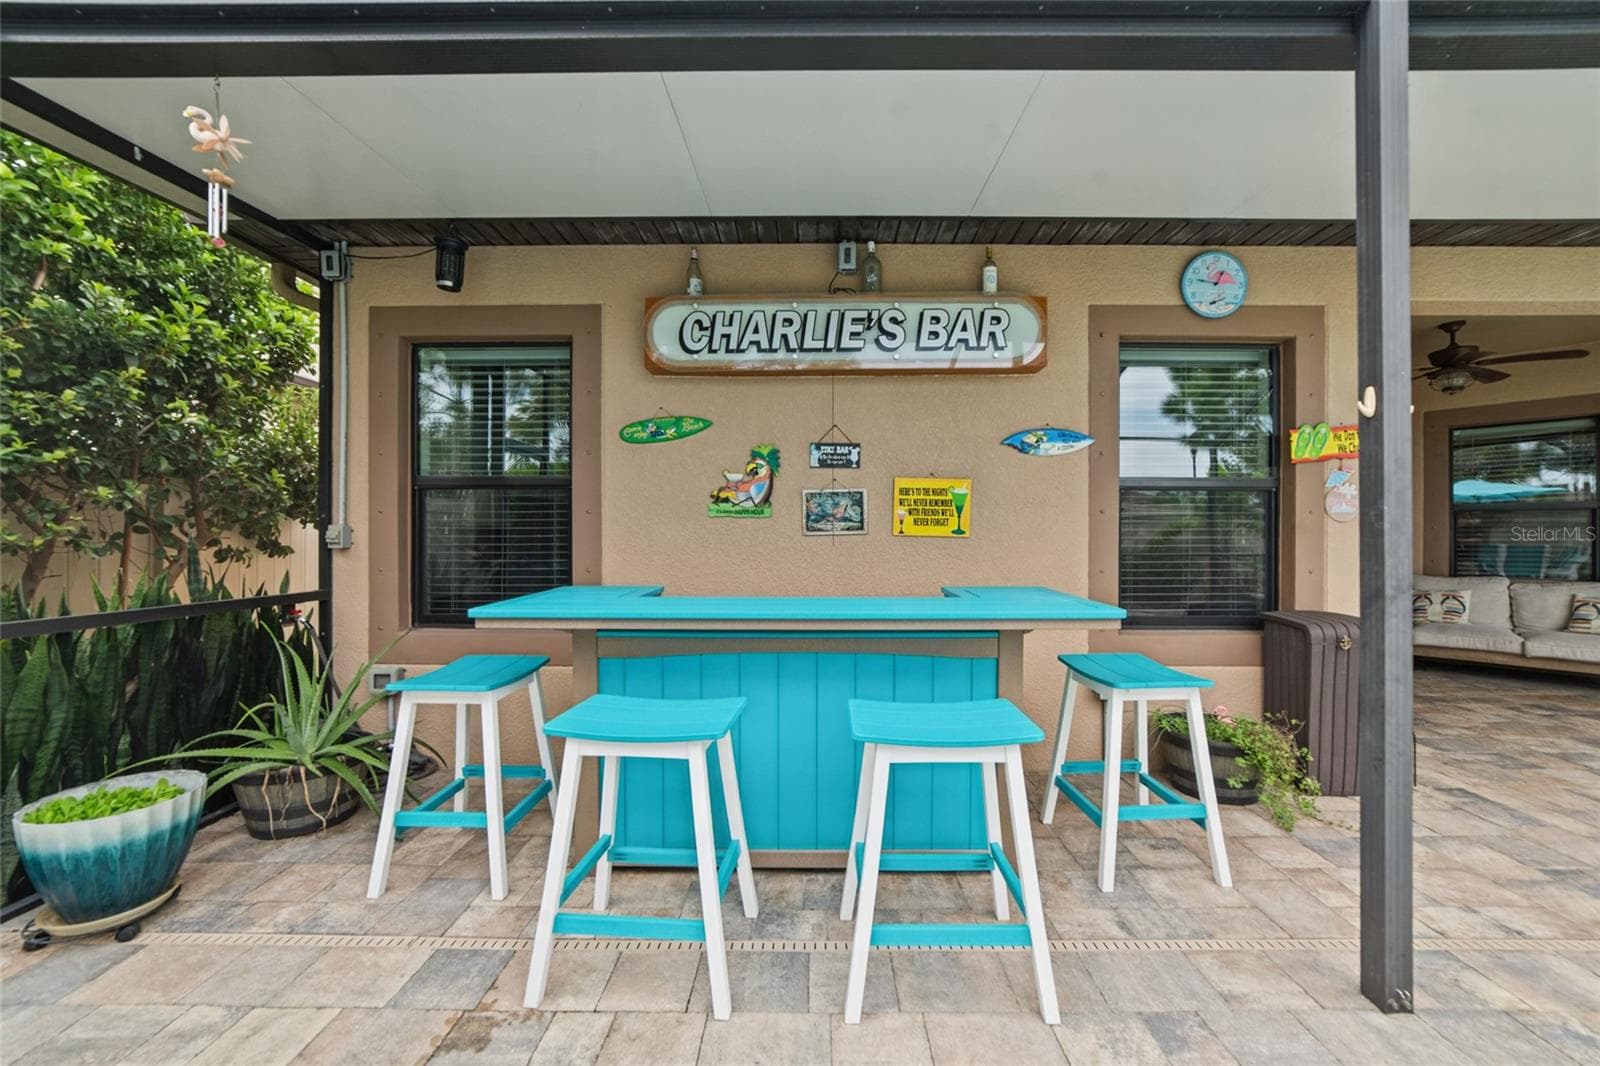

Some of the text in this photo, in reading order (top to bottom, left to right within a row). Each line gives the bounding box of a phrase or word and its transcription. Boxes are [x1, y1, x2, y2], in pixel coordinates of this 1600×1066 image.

[679, 307, 1011, 353] CHARLIE'S BAR
[836, 445, 849, 454] BAR
[899, 487, 948, 497] HERE'S TO THE NIGHTS
[899, 498, 953, 507] WE'LL NEVER REMEMBER
[908, 508, 954, 517] WITH FRIENDS WE'LL
[913, 517, 949, 526] NEVER FORGET
